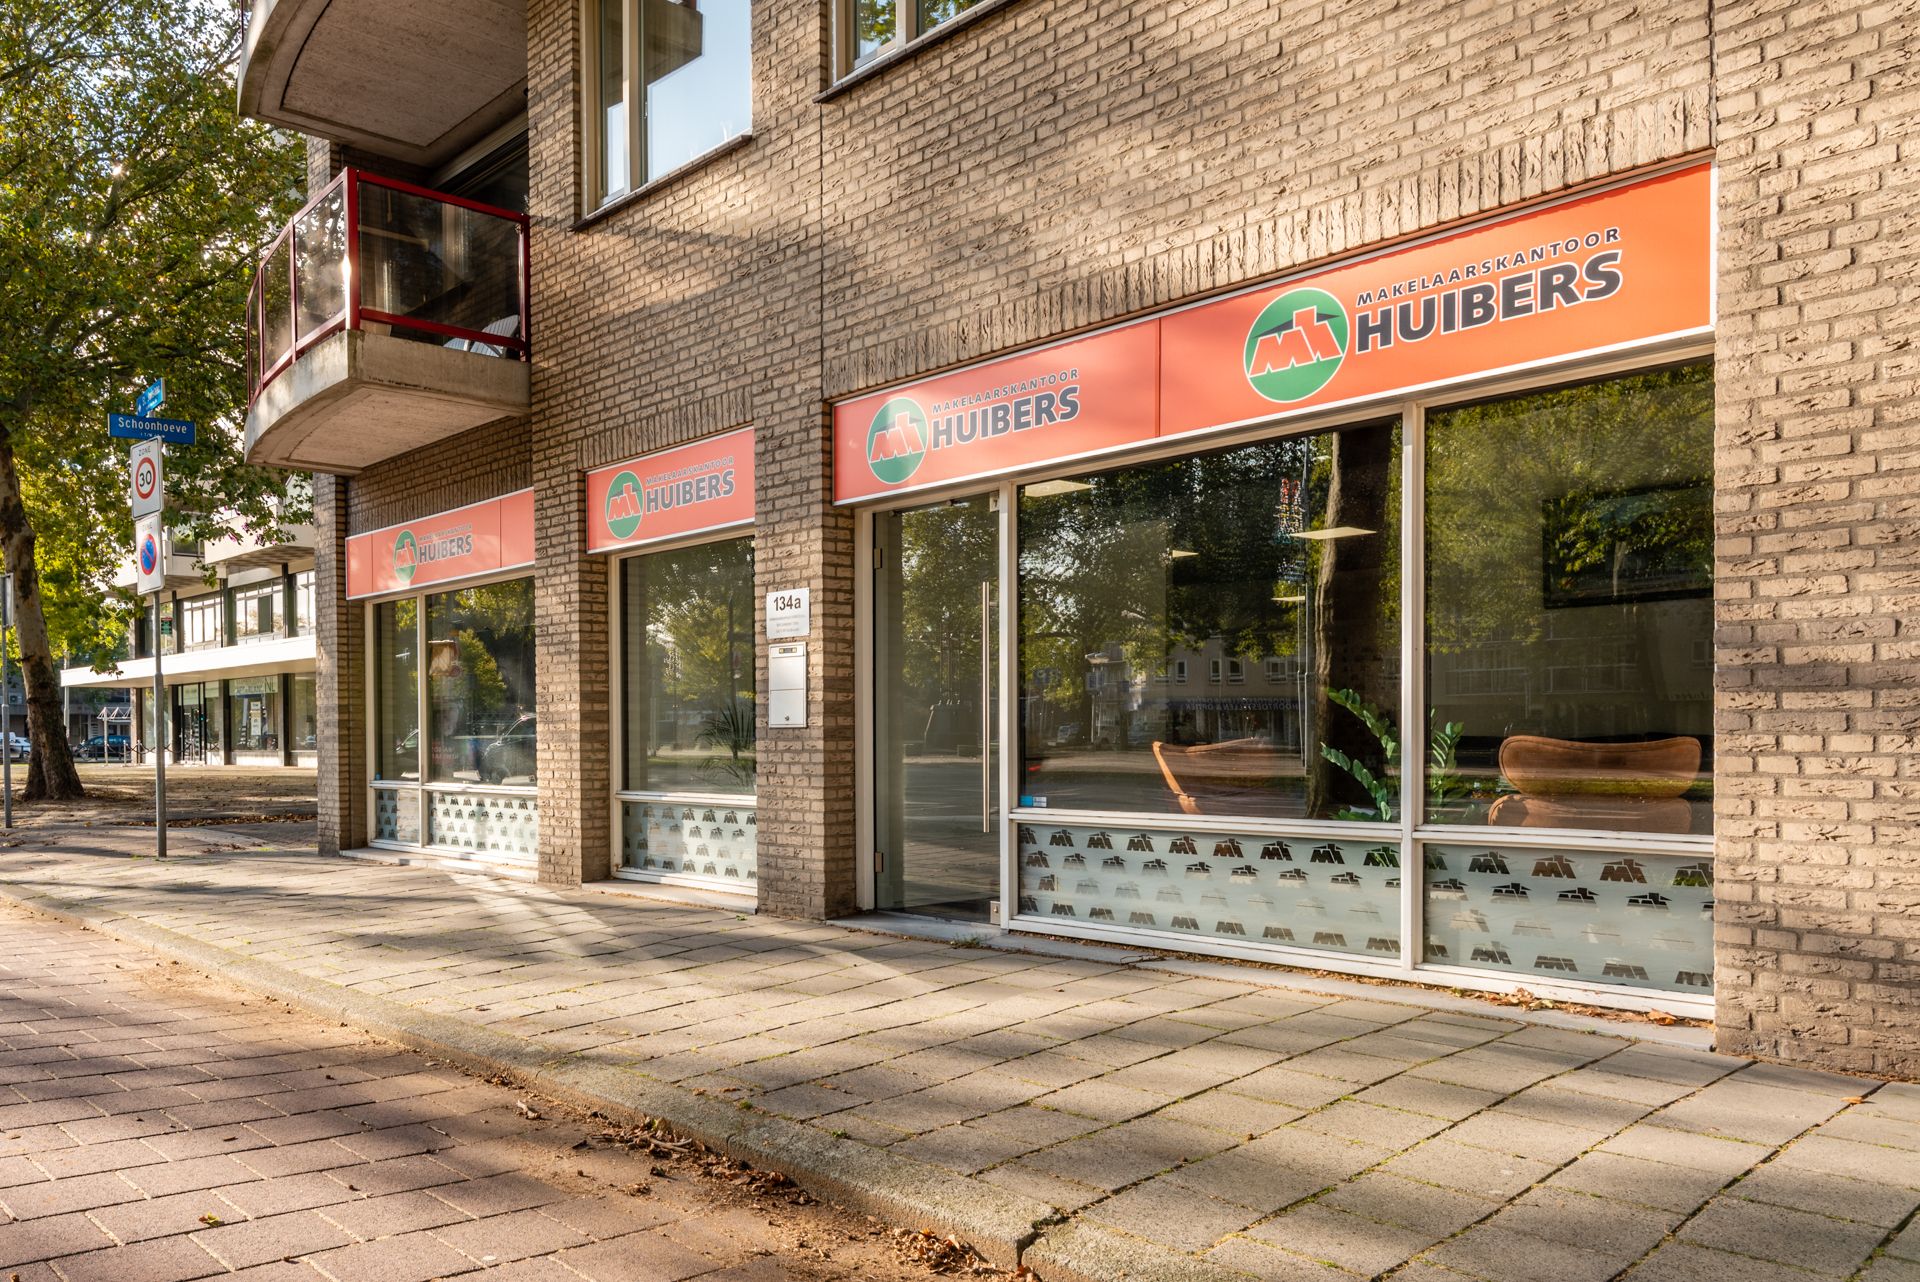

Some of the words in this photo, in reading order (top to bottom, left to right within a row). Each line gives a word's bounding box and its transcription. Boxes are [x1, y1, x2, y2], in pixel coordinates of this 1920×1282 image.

[1356, 225, 1621, 308] MAKELAARSKANTOOR
[1355, 249, 1623, 354] HUIBERS
[932, 368, 1079, 415] MAKELAARSKANTOOR
[118, 417, 187, 434] Schoonhoeve
[931, 385, 1080, 450] HUIBERS
[139, 470, 152, 487] 30
[646, 455, 734, 486] MAKELAARSKANTOOR
[646, 469, 735, 515] HUIBERS
[418, 534, 473, 565] HUIBERS
[773, 594, 802, 612] 134a
